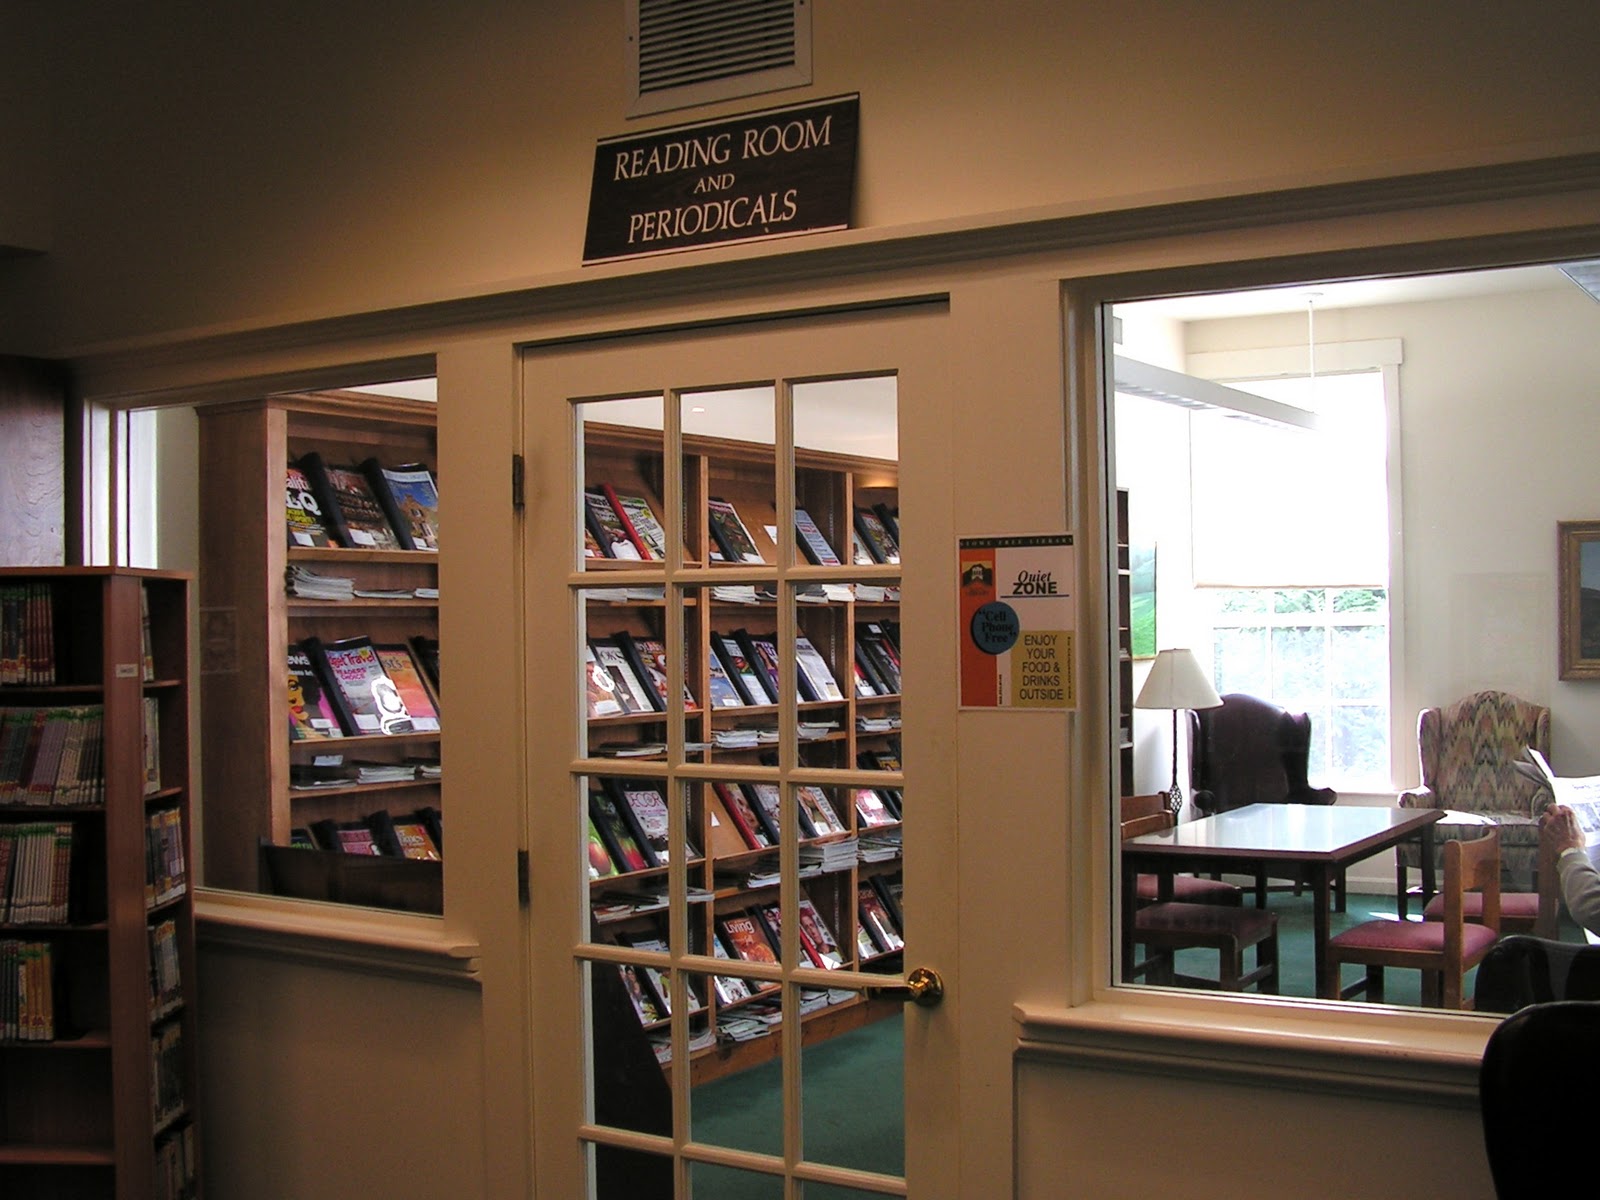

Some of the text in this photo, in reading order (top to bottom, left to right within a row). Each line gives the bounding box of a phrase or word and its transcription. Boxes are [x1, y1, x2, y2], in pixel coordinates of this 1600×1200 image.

[613, 115, 833, 181] READING ROOM
[693, 173, 735, 194] AND
[627, 189, 798, 244] PERIODICALS
[1029, 537, 1073, 545] LIBRARY
[1018, 570, 1052, 583] Quiet
[1012, 582, 1058, 595] ZONE
[981, 622, 1014, 633] Phone
[1024, 635, 1058, 646] ENJOY
[1026, 648, 1056, 660] YOUR
[1022, 662, 1061, 673] FOOD &
[1022, 675, 1060, 687] DRINKS
[1019, 689, 1064, 701] OUTSIDE
[723, 920, 755, 935] Living
